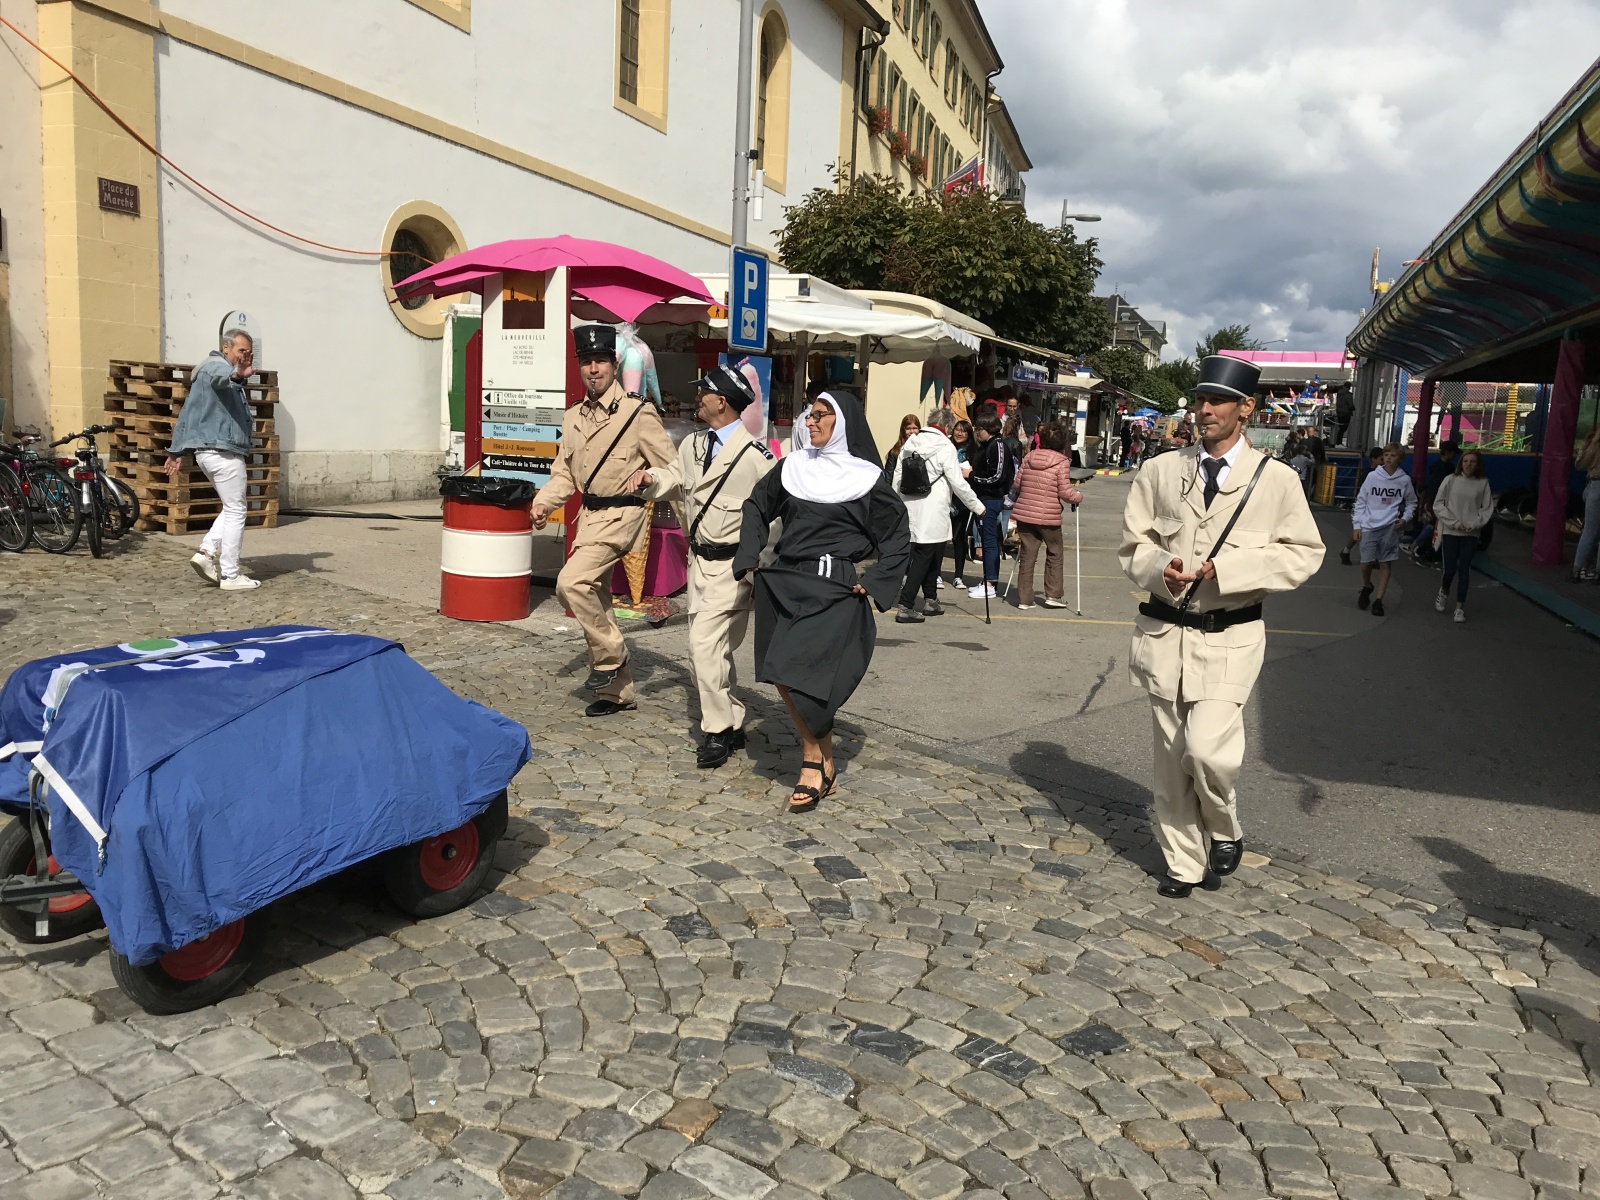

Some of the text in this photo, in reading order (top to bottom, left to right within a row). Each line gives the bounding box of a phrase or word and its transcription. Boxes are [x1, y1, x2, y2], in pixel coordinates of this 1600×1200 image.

[101, 180, 135, 196] Place du
[103, 192, 134, 208] Marché
[744, 260, 759, 304] P
[507, 411, 529, 419] d'Histoire
[491, 459, 518, 467] Café-Théâtre
[1371, 486, 1402, 497] NASA
